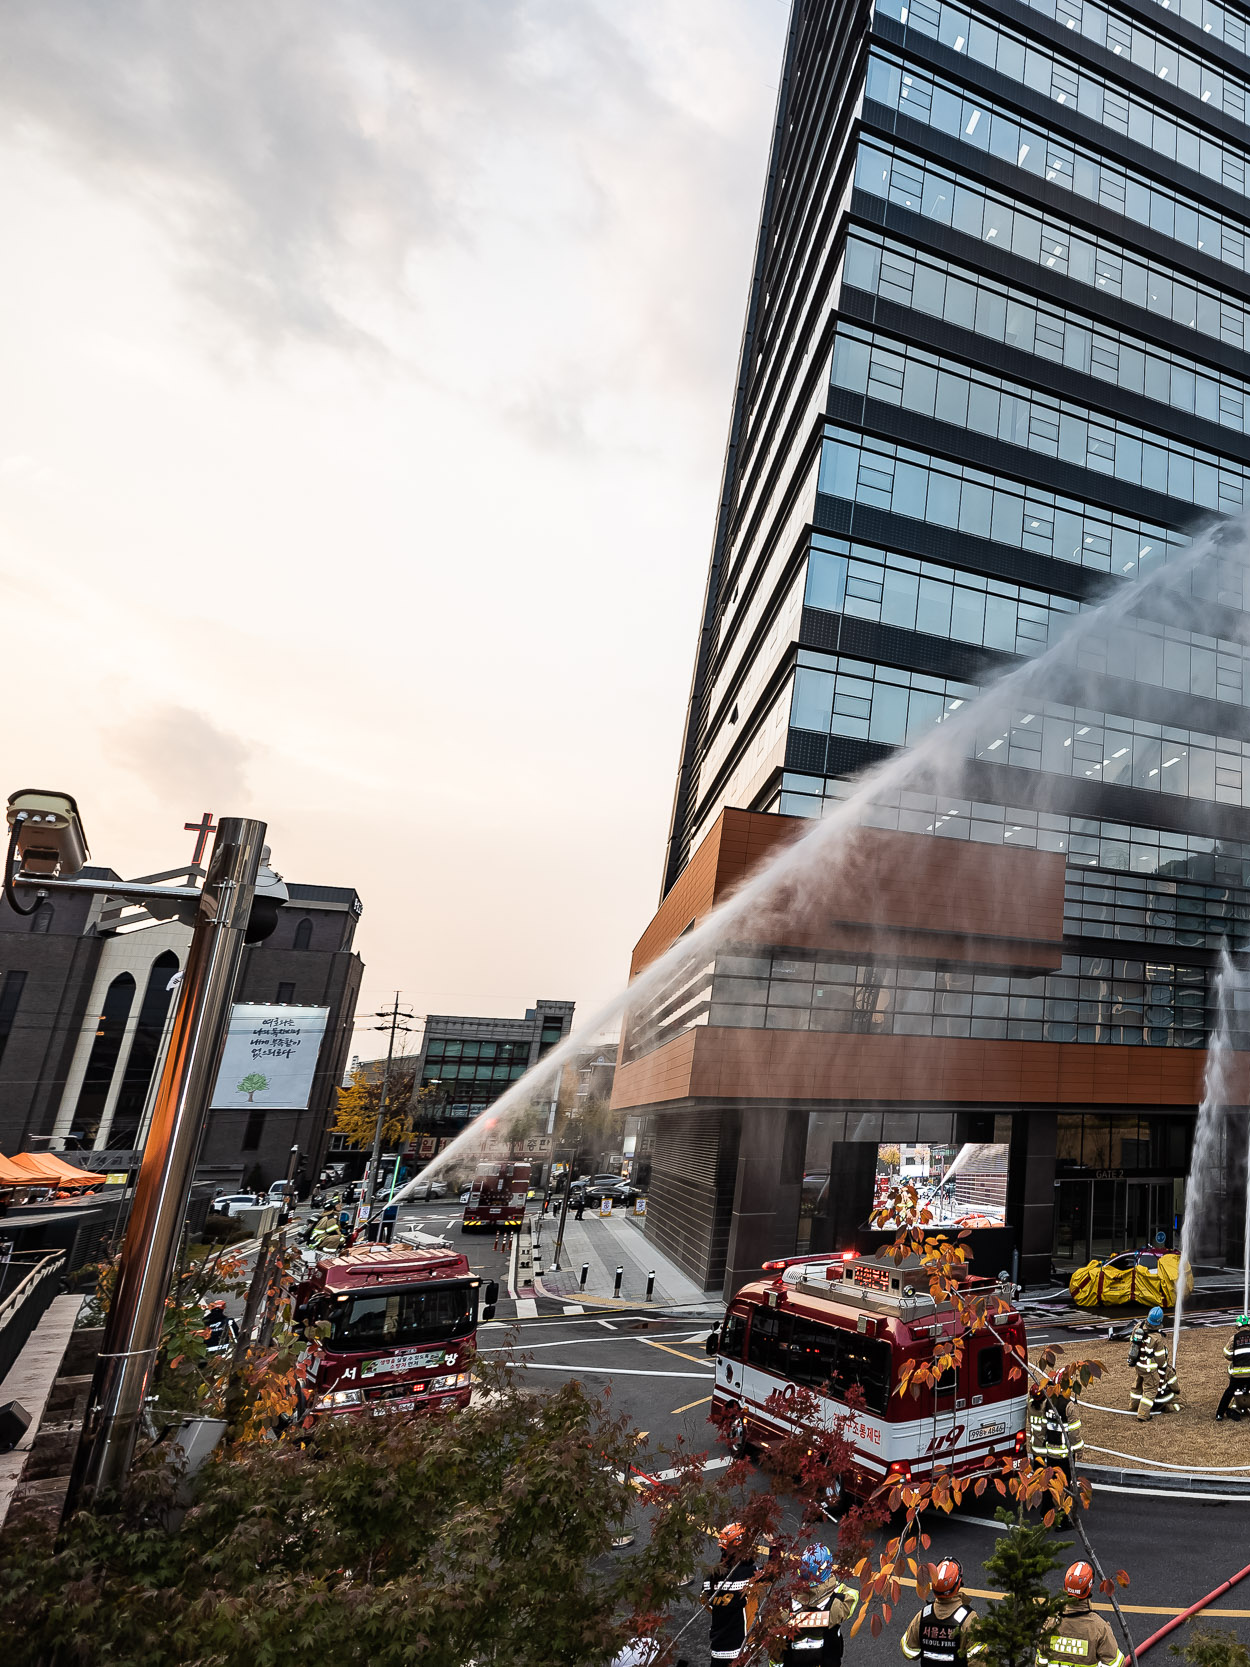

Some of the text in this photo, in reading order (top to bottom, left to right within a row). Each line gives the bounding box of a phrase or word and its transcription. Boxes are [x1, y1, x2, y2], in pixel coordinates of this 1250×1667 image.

[1095, 1169, 1124, 1179] GATE 2
[925, 1424, 965, 1456] 119
[712, 1593, 734, 1607] 119
